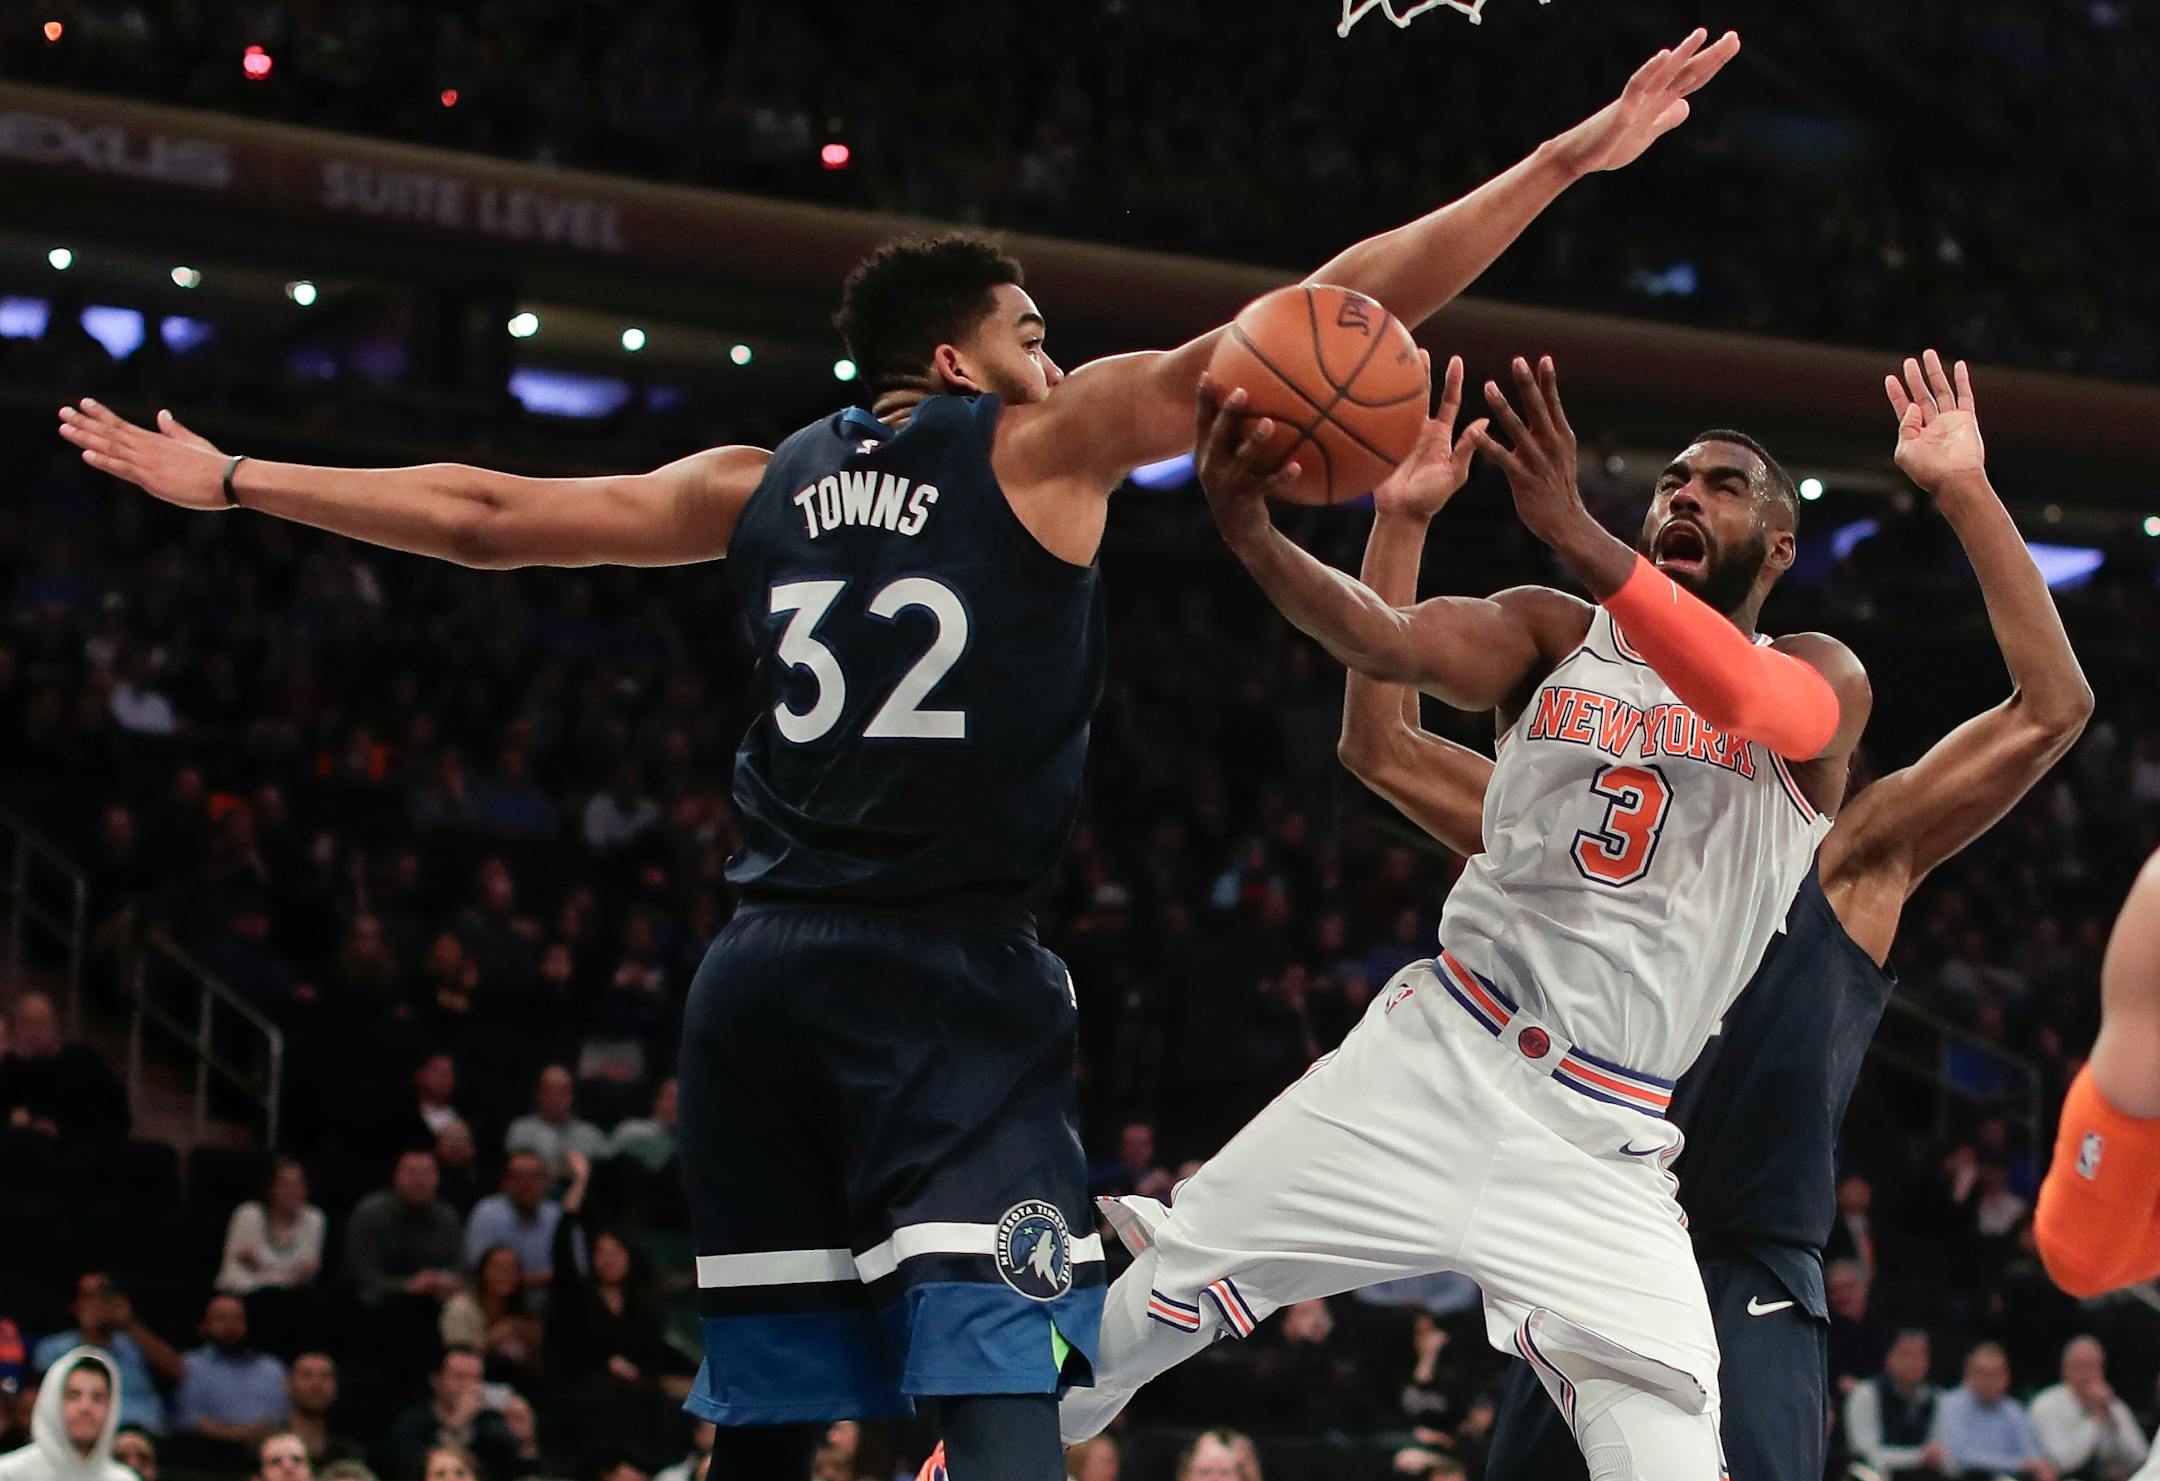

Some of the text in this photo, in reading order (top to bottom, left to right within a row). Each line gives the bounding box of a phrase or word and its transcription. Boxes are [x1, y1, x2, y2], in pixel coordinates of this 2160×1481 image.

[0, 111, 231, 189] EXUS
[321, 160, 626, 254] SUITE LEVEL
[793, 470, 939, 539] TOWNS
[769, 576, 969, 744] 32
[1527, 686, 1756, 781] NEW YORK
[1569, 763, 1674, 888] 3
[998, 1206, 1034, 1266] MINNESOTA
